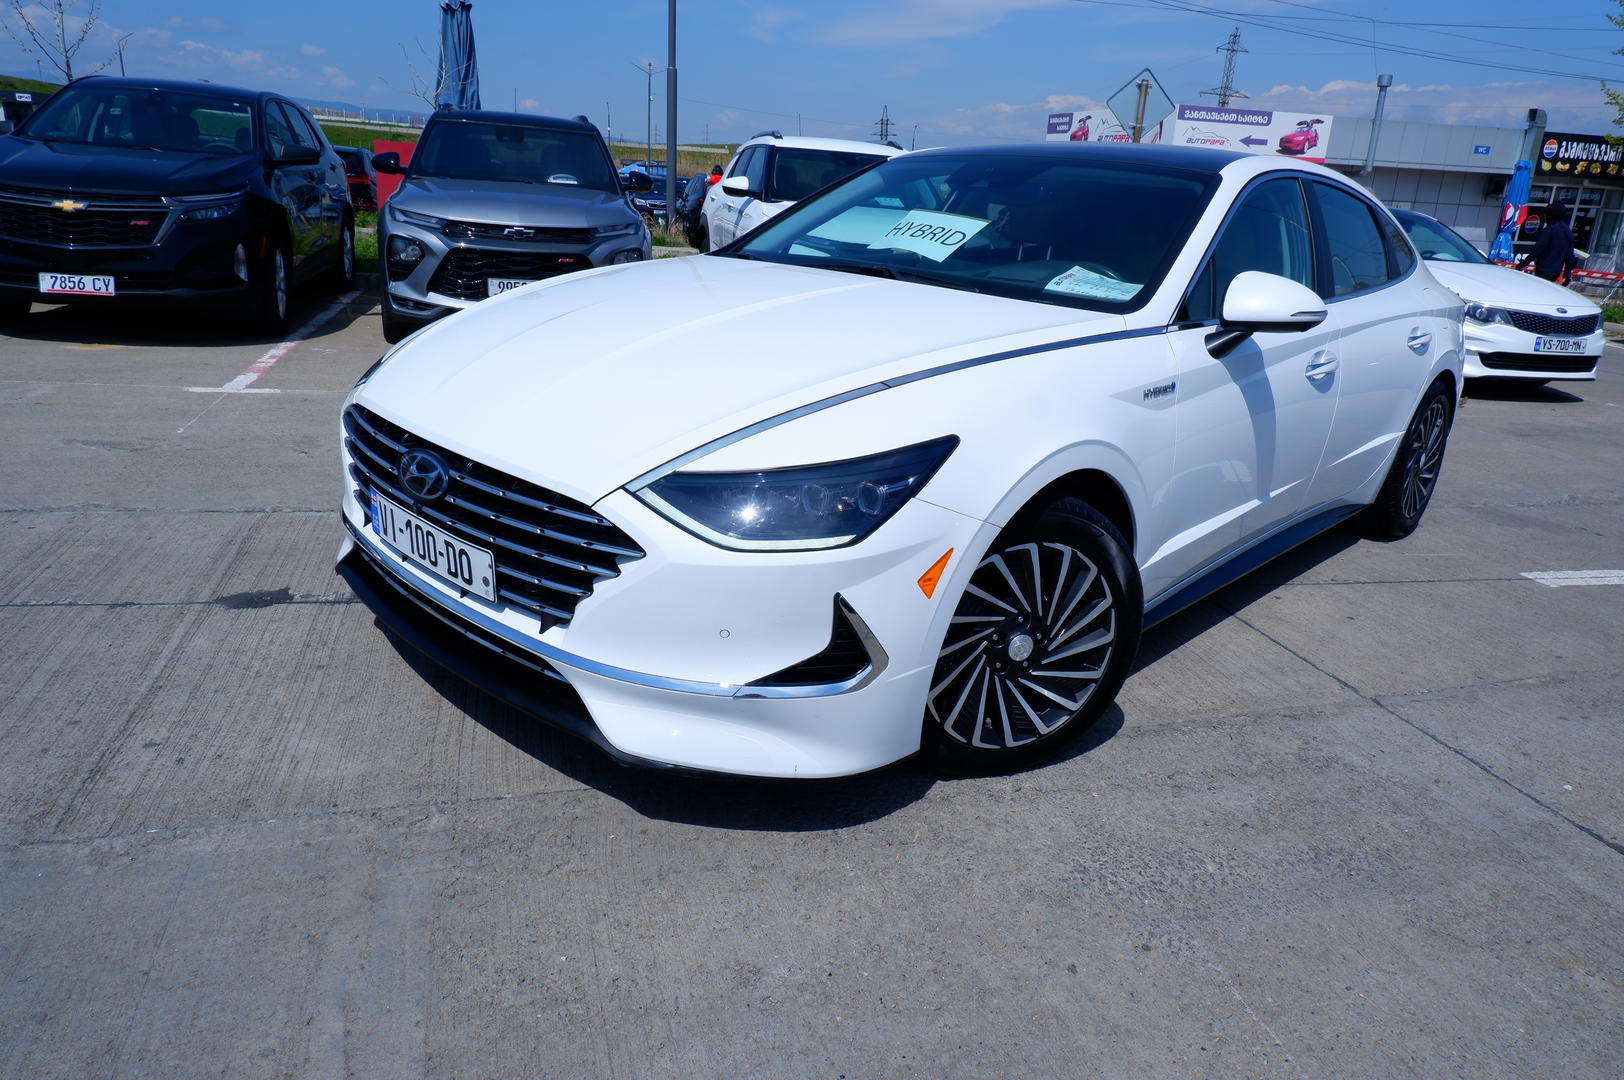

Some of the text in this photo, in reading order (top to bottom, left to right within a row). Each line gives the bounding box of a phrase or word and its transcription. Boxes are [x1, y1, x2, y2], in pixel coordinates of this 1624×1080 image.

[885, 222, 966, 246] HYBRID
[50, 275, 111, 292] 7856 CY
[379, 500, 474, 586] VI-100-DO
